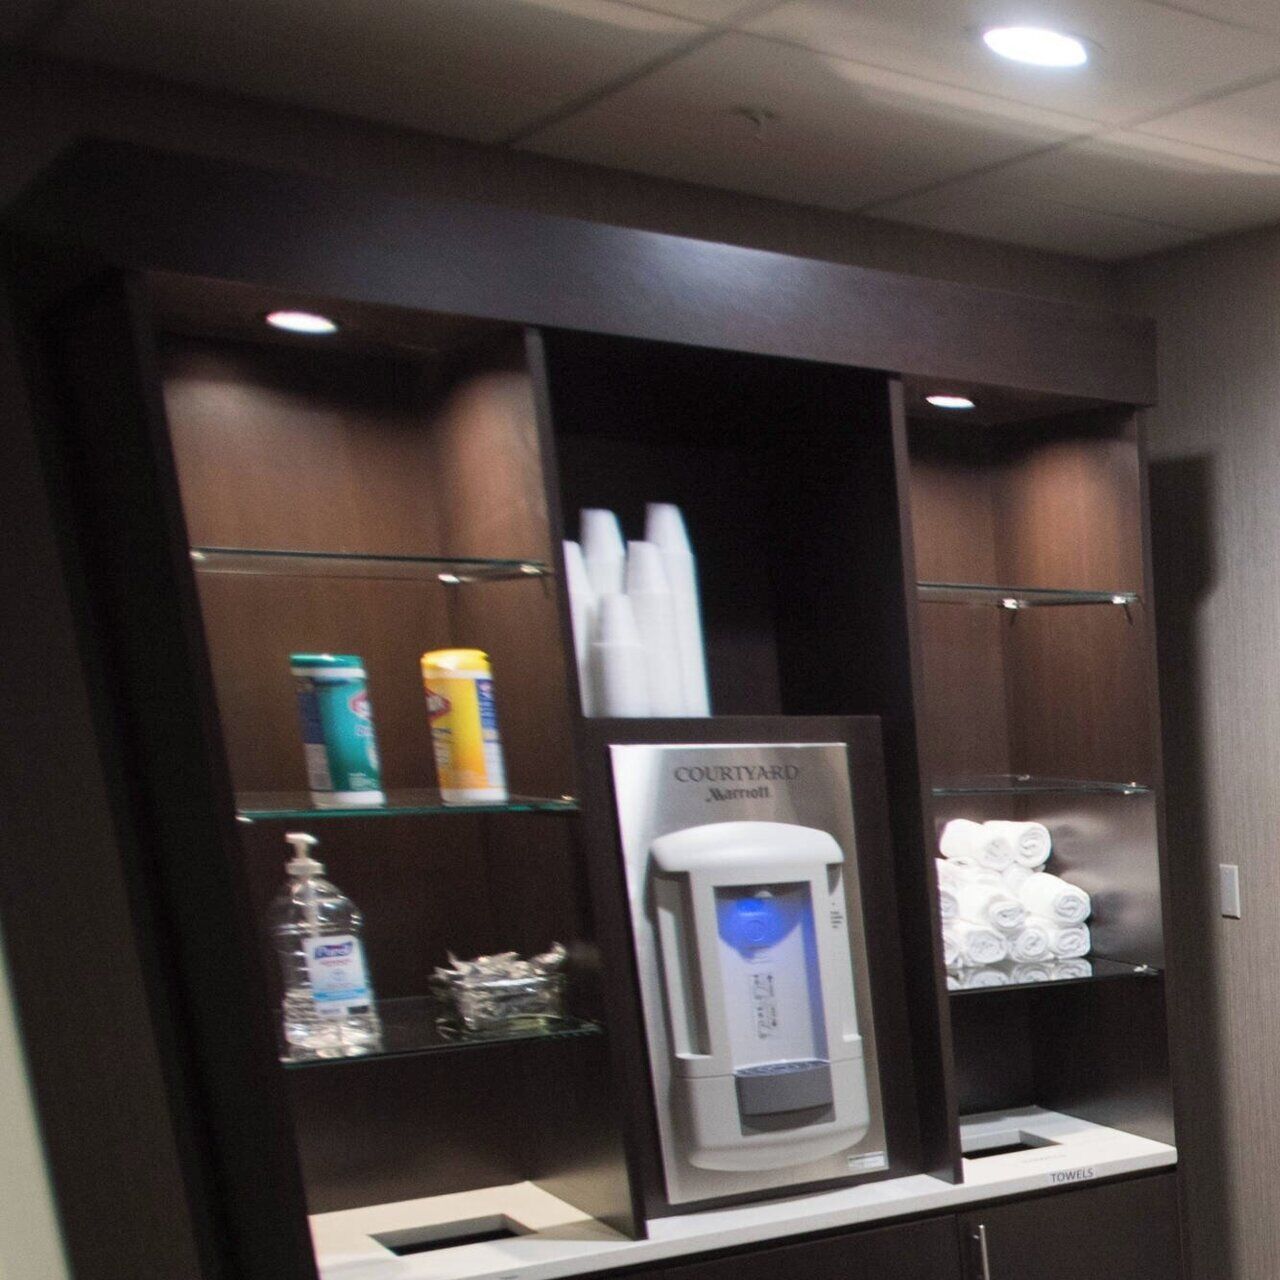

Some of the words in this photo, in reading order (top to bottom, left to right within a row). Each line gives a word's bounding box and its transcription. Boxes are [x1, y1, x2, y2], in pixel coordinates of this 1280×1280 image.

[674, 764, 799, 783] COURTYARD
[706, 786, 769, 802] Marriott
[1049, 1168, 1094, 1183] TOWELS
